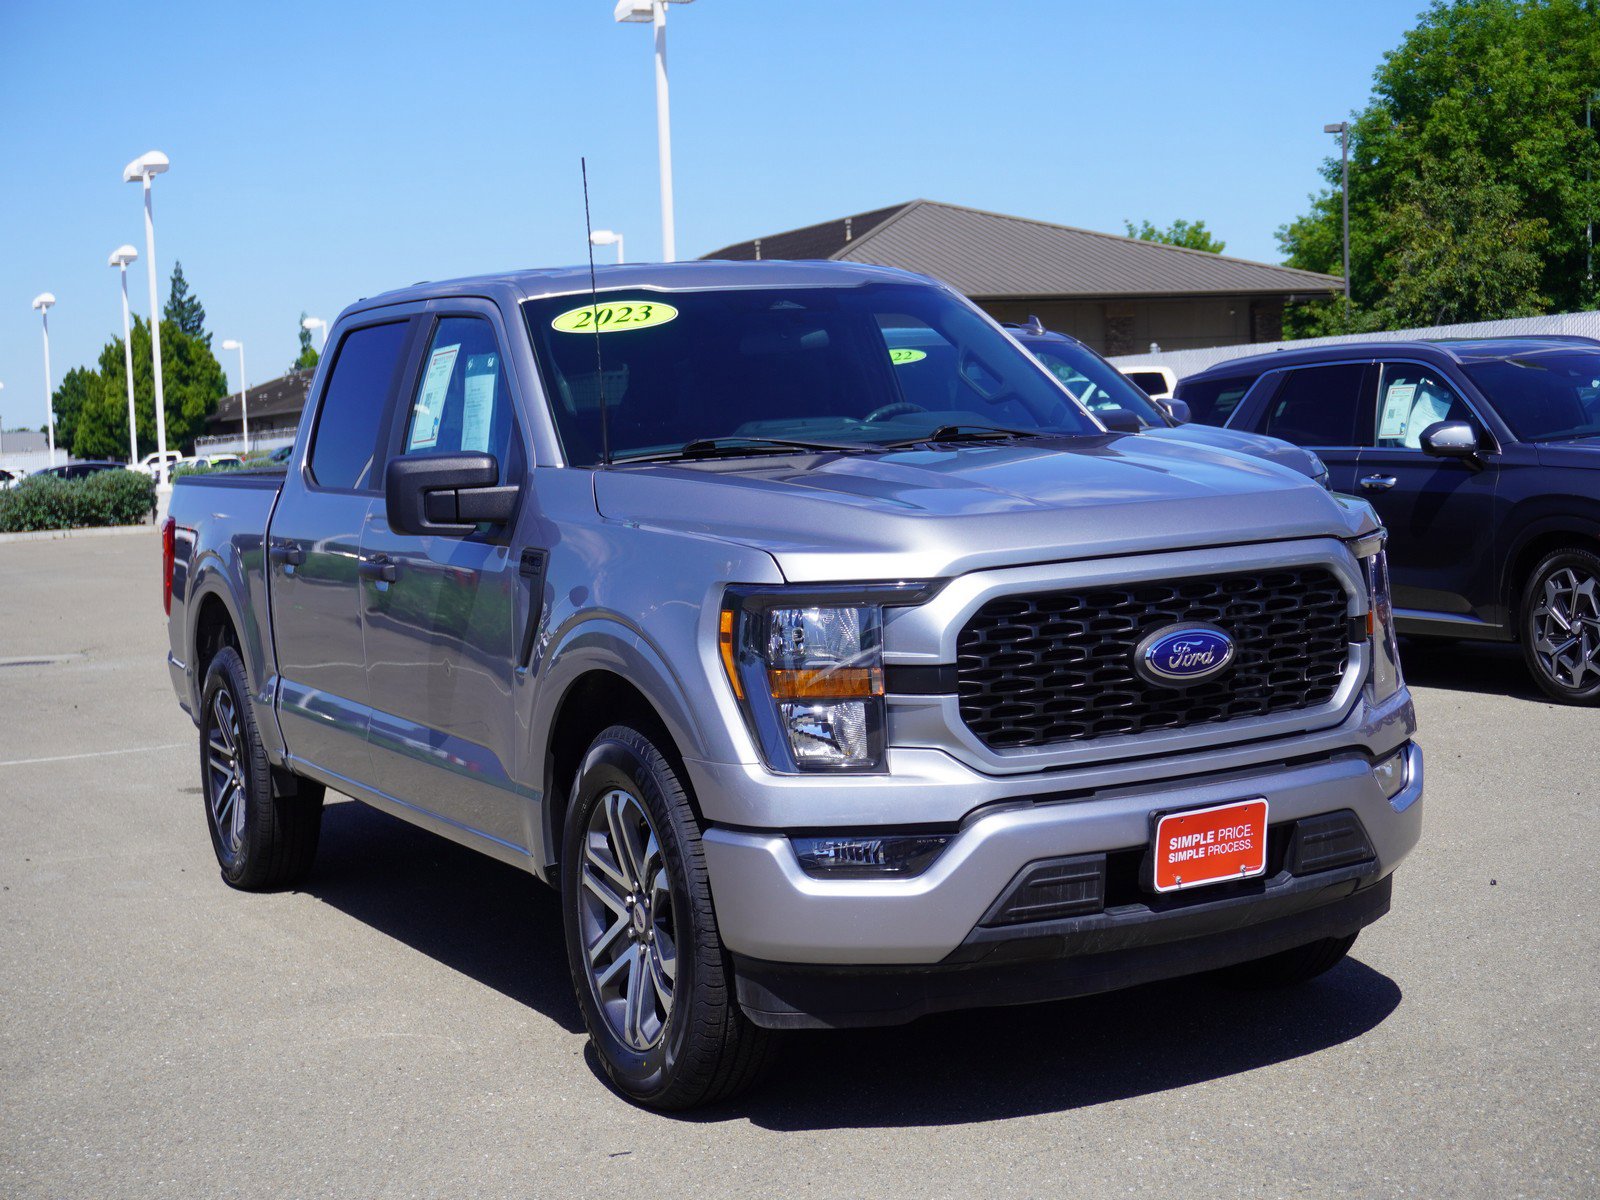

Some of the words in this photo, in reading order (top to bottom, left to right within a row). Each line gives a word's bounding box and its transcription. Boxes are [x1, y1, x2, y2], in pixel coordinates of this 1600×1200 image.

[572, 305, 653, 329] 2023
[1168, 640, 1215, 669] Ford
[1169, 831, 1215, 850] SIMPLE
[1217, 824, 1254, 842] PRICE.
[1168, 847, 1206, 863] SIMPLE
[1207, 839, 1254, 857] PROCESS.
